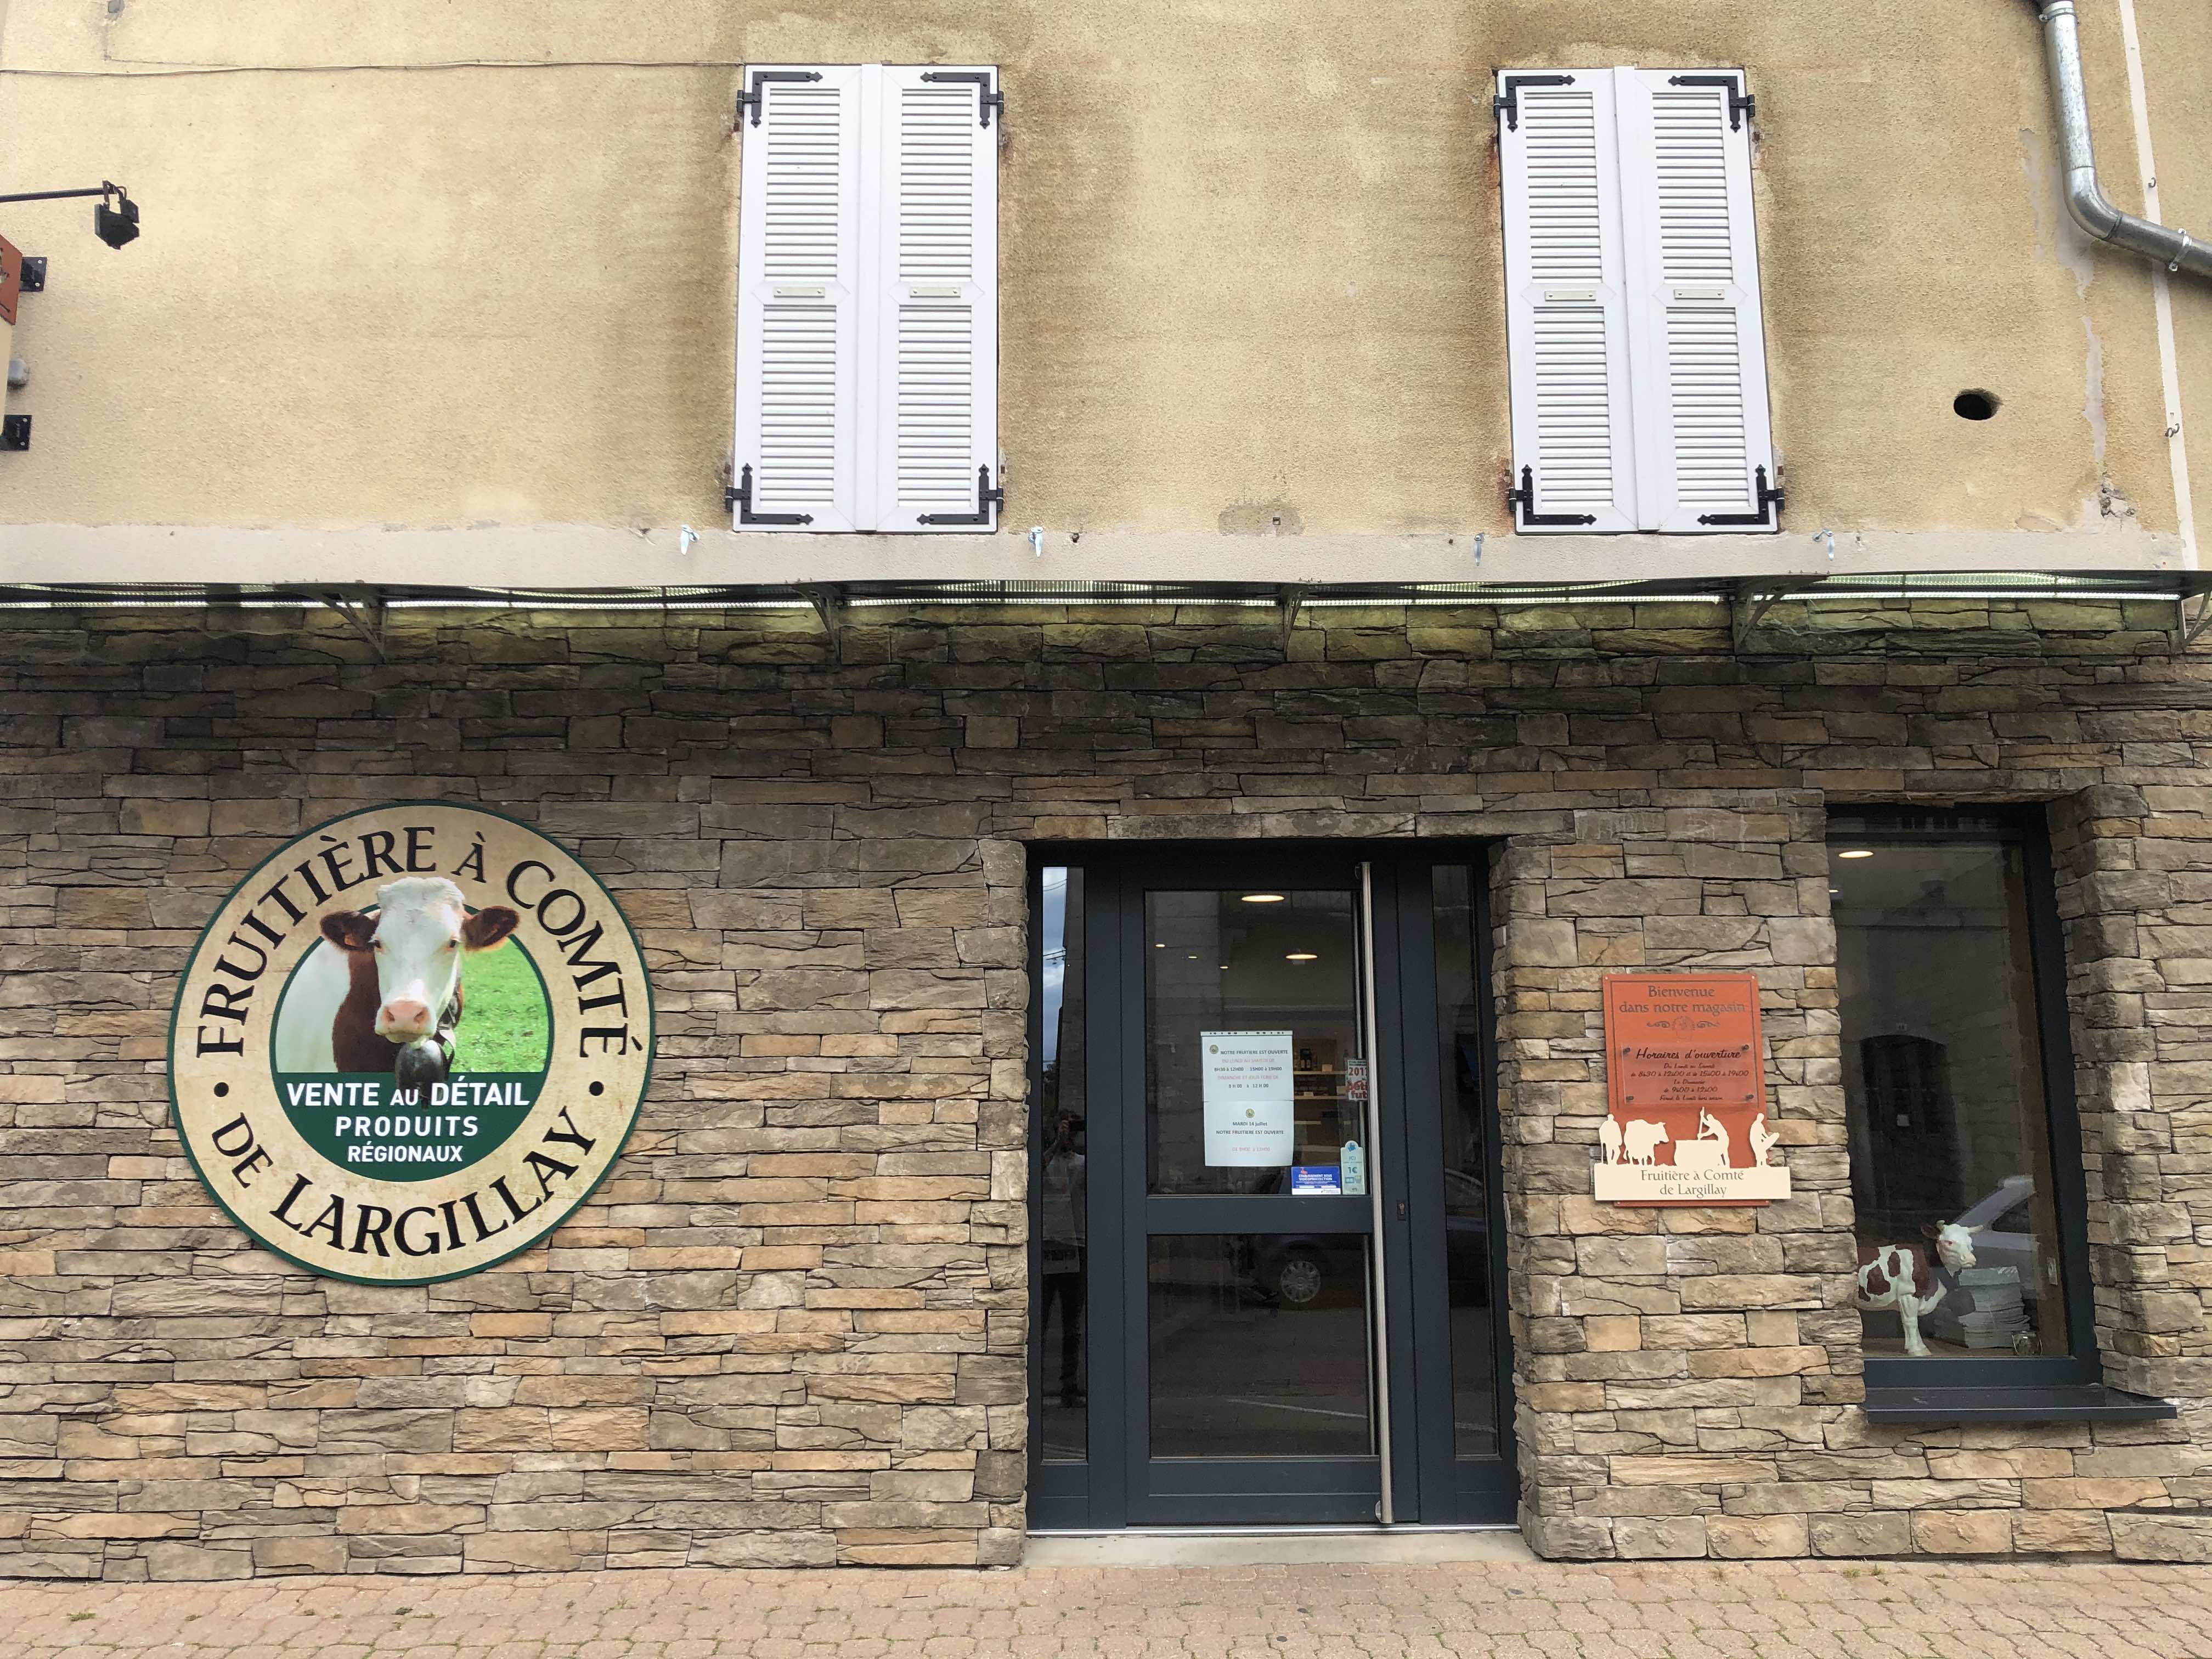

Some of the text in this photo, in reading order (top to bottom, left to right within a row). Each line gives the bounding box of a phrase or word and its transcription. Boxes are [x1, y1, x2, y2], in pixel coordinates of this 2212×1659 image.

[196, 827, 643, 1058] FRUITIÈRE À COMTÉ
[1647, 985, 1716, 997] Bienvenue
[1619, 1001, 1746, 1017] dans notre magasin
[1636, 1047, 1741, 1059] Horaires d'ouverture
[286, 1075, 531, 1107] VENTE AU DÉTAIL
[335, 1116, 478, 1137] PRODUITS
[347, 1141, 463, 1163] RÉGIONAUX
[212, 1107, 596, 1257] DE LARGILLAY
[1641, 1169, 1744, 1181] Fruitière à Comté
[1660, 1183, 1727, 1199] de Largillay
